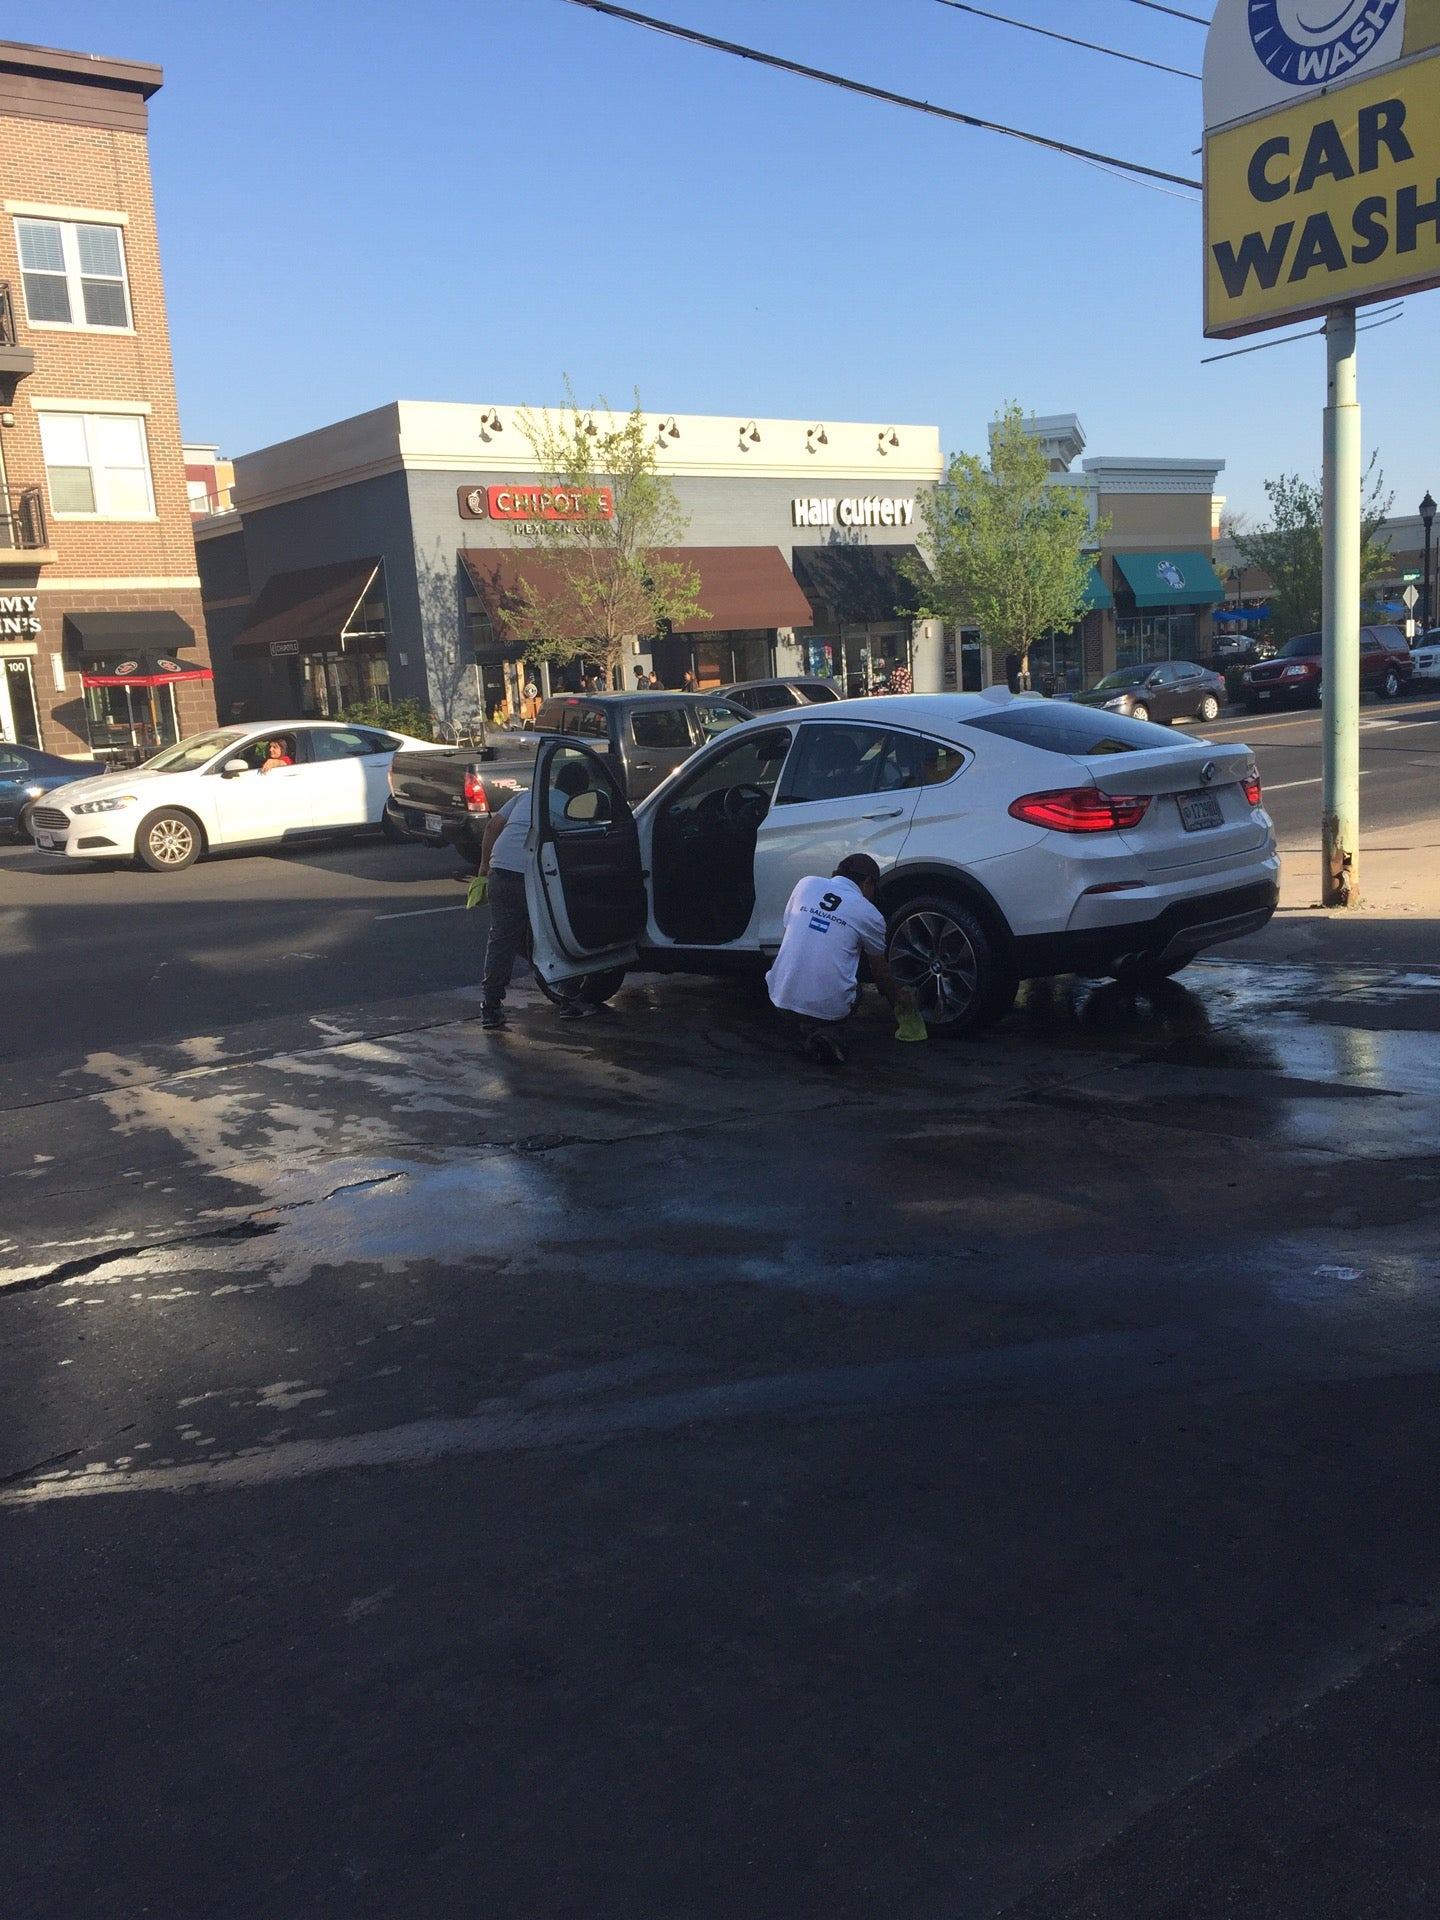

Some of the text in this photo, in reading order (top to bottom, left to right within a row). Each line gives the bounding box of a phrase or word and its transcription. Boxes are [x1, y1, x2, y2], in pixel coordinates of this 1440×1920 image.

[1297, 0, 1396, 81] WASH
[1247, 98, 1415, 203] CAR
[1211, 177, 1440, 299] WASH
[497, 492, 610, 513] CHIPOTE
[792, 498, 836, 527] Hair
[8, 662, 25, 673] 100
[819, 892, 843, 912] 9
[809, 908, 847, 927] SALVADOR
